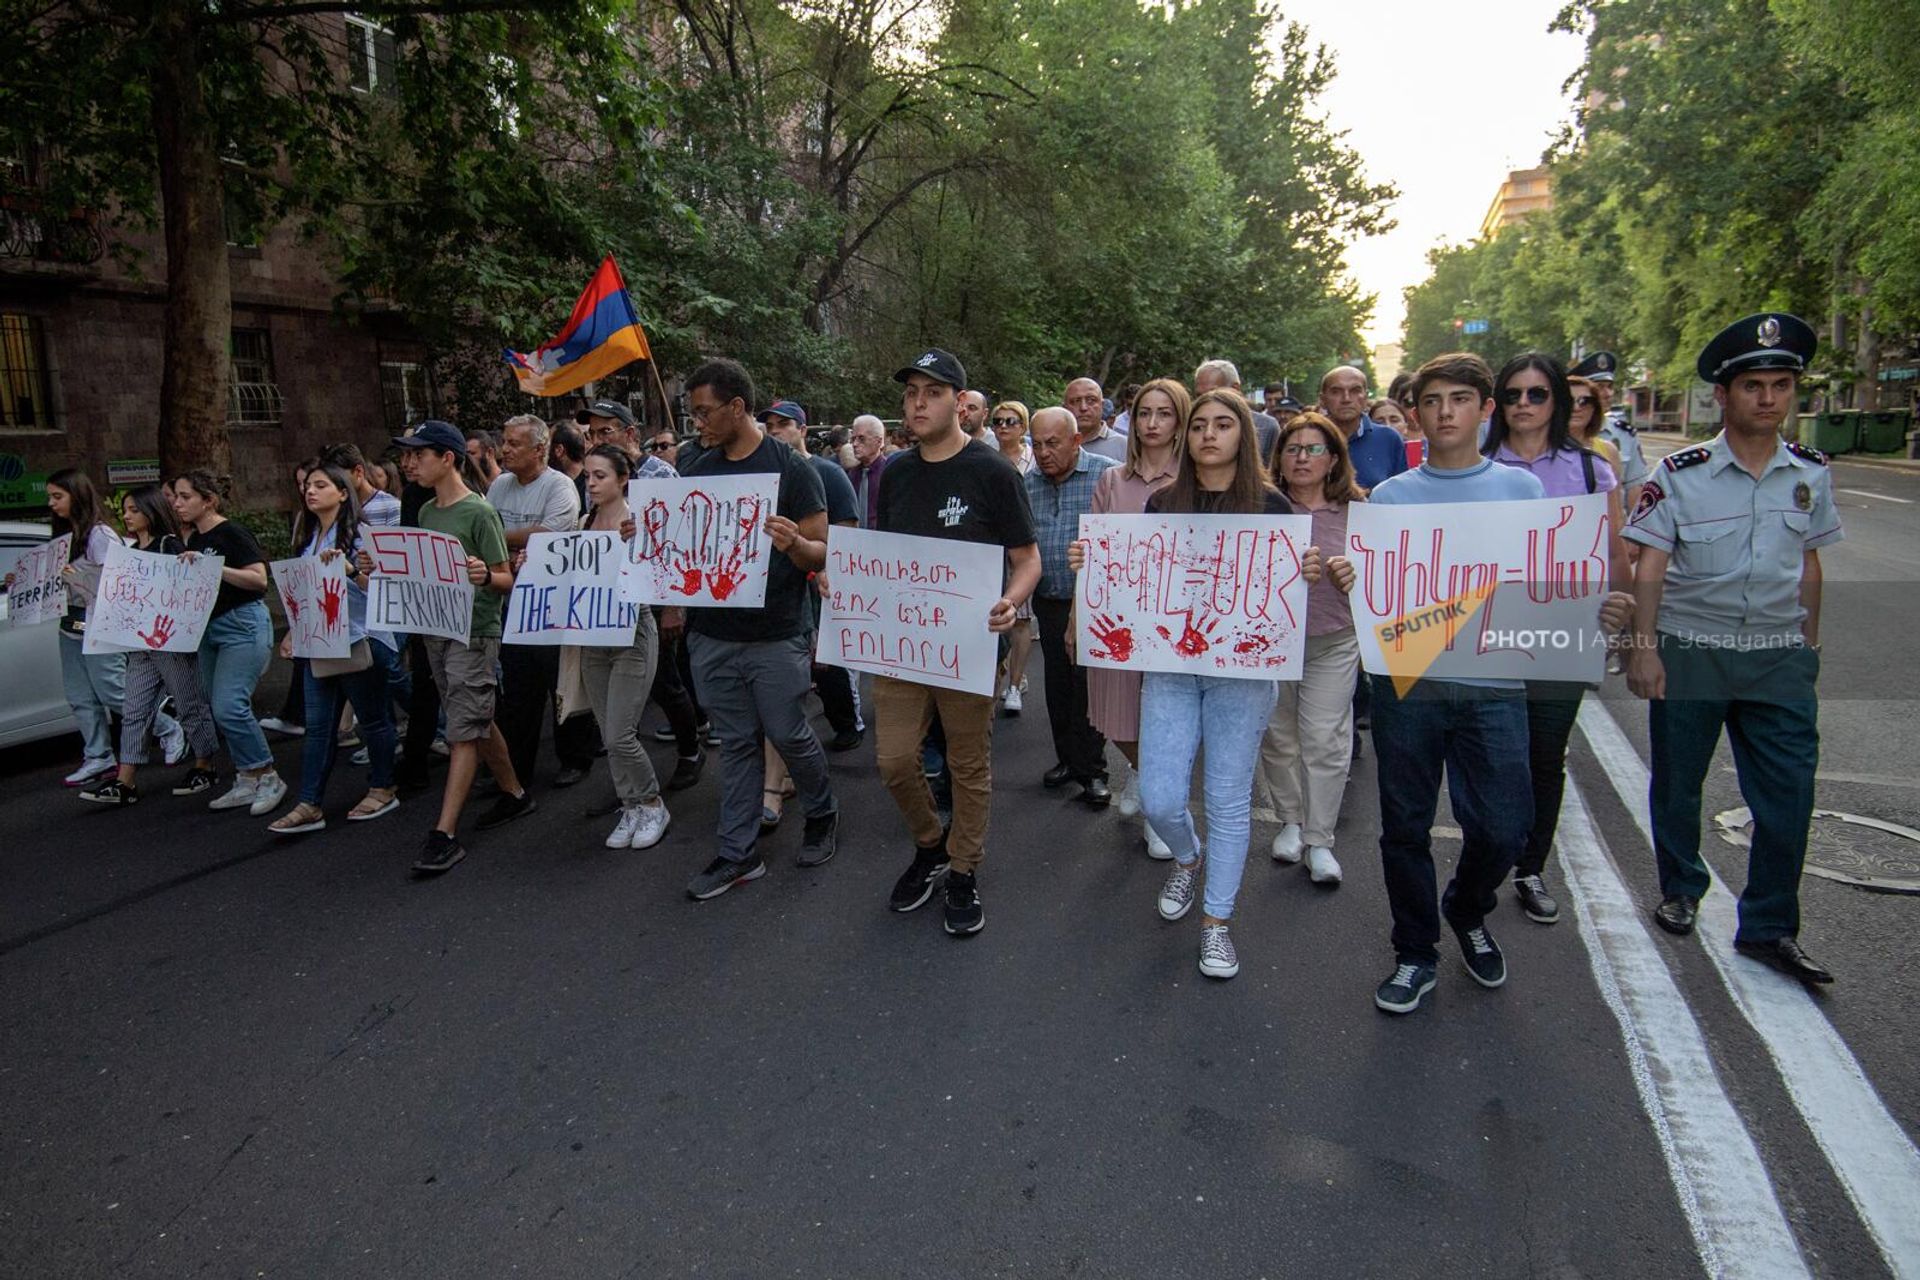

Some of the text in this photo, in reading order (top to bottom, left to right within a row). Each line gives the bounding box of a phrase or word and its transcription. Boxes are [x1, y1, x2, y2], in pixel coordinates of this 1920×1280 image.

[371, 532, 467, 585] STOP
[545, 533, 612, 576] STOP
[515, 584, 636, 634] THE KILLER
